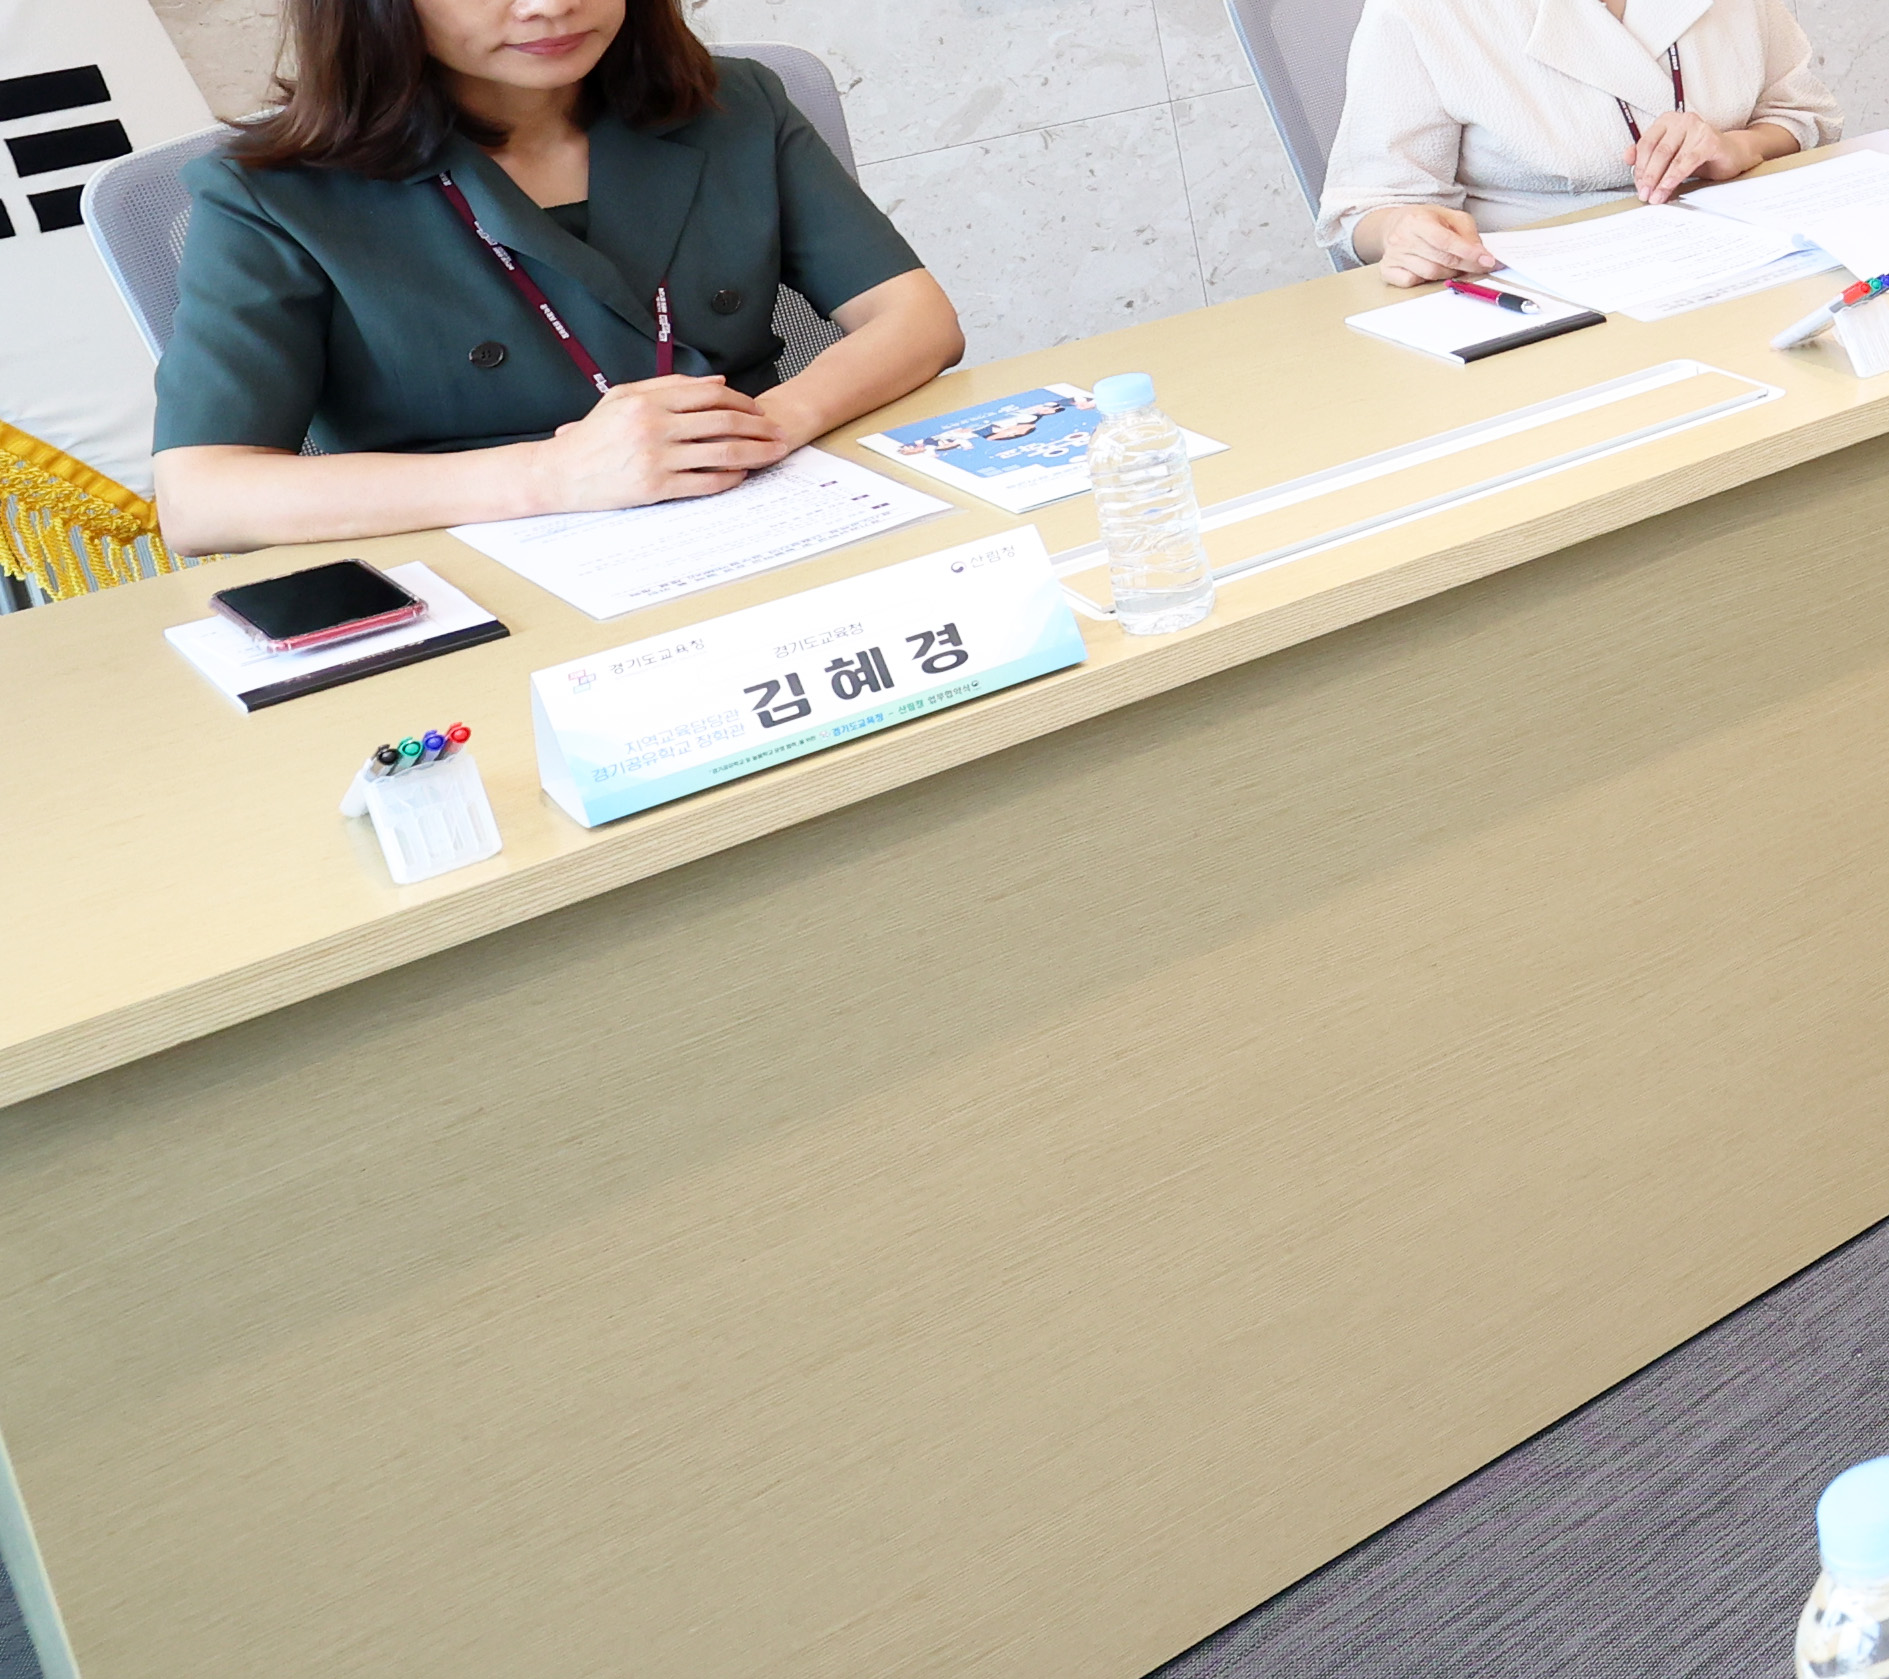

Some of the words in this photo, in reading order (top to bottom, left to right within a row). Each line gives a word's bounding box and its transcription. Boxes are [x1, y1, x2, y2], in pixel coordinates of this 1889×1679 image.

[970, 545, 1017, 569] 산림청
[608, 638, 706, 676] 경기도교육청
[773, 620, 865, 660] 경기도교육청
[624, 707, 741, 756] 지역교육담당관
[831, 712, 885, 738] 경기도교육청
[590, 740, 692, 784] 경기공유학교
[698, 721, 747, 751] 장학관
